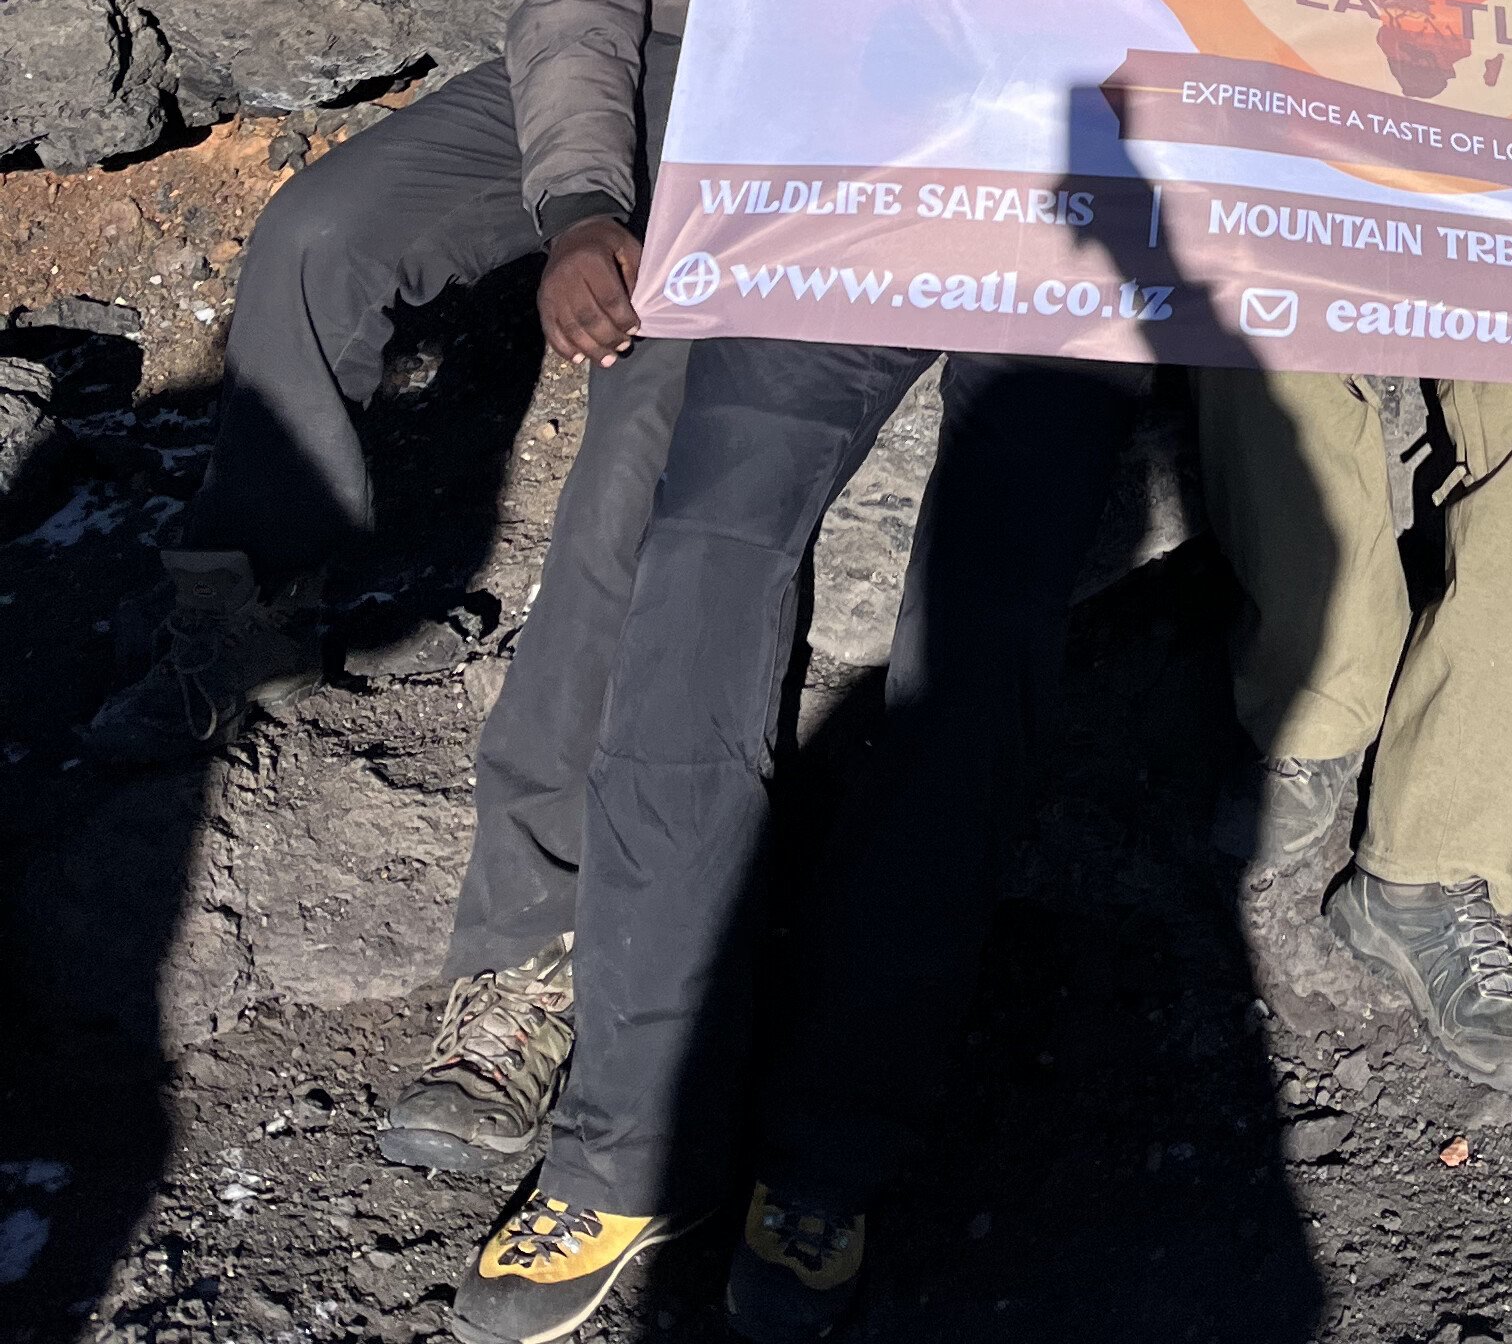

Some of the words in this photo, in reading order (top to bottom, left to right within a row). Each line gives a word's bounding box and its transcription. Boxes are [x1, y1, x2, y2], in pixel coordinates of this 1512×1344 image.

[1182, 81, 1341, 125] EXPERIENCE
[1345, 110, 1366, 131] A
[1367, 113, 1444, 148] TASTE
[1450, 132, 1486, 156] OF
[699, 179, 902, 217] WILDLIFE
[917, 184, 1096, 228] SAFARIS
[1208, 199, 1423, 257] MOUNTAIN
[730, 263, 1176, 321] www.eatl.co.tz
